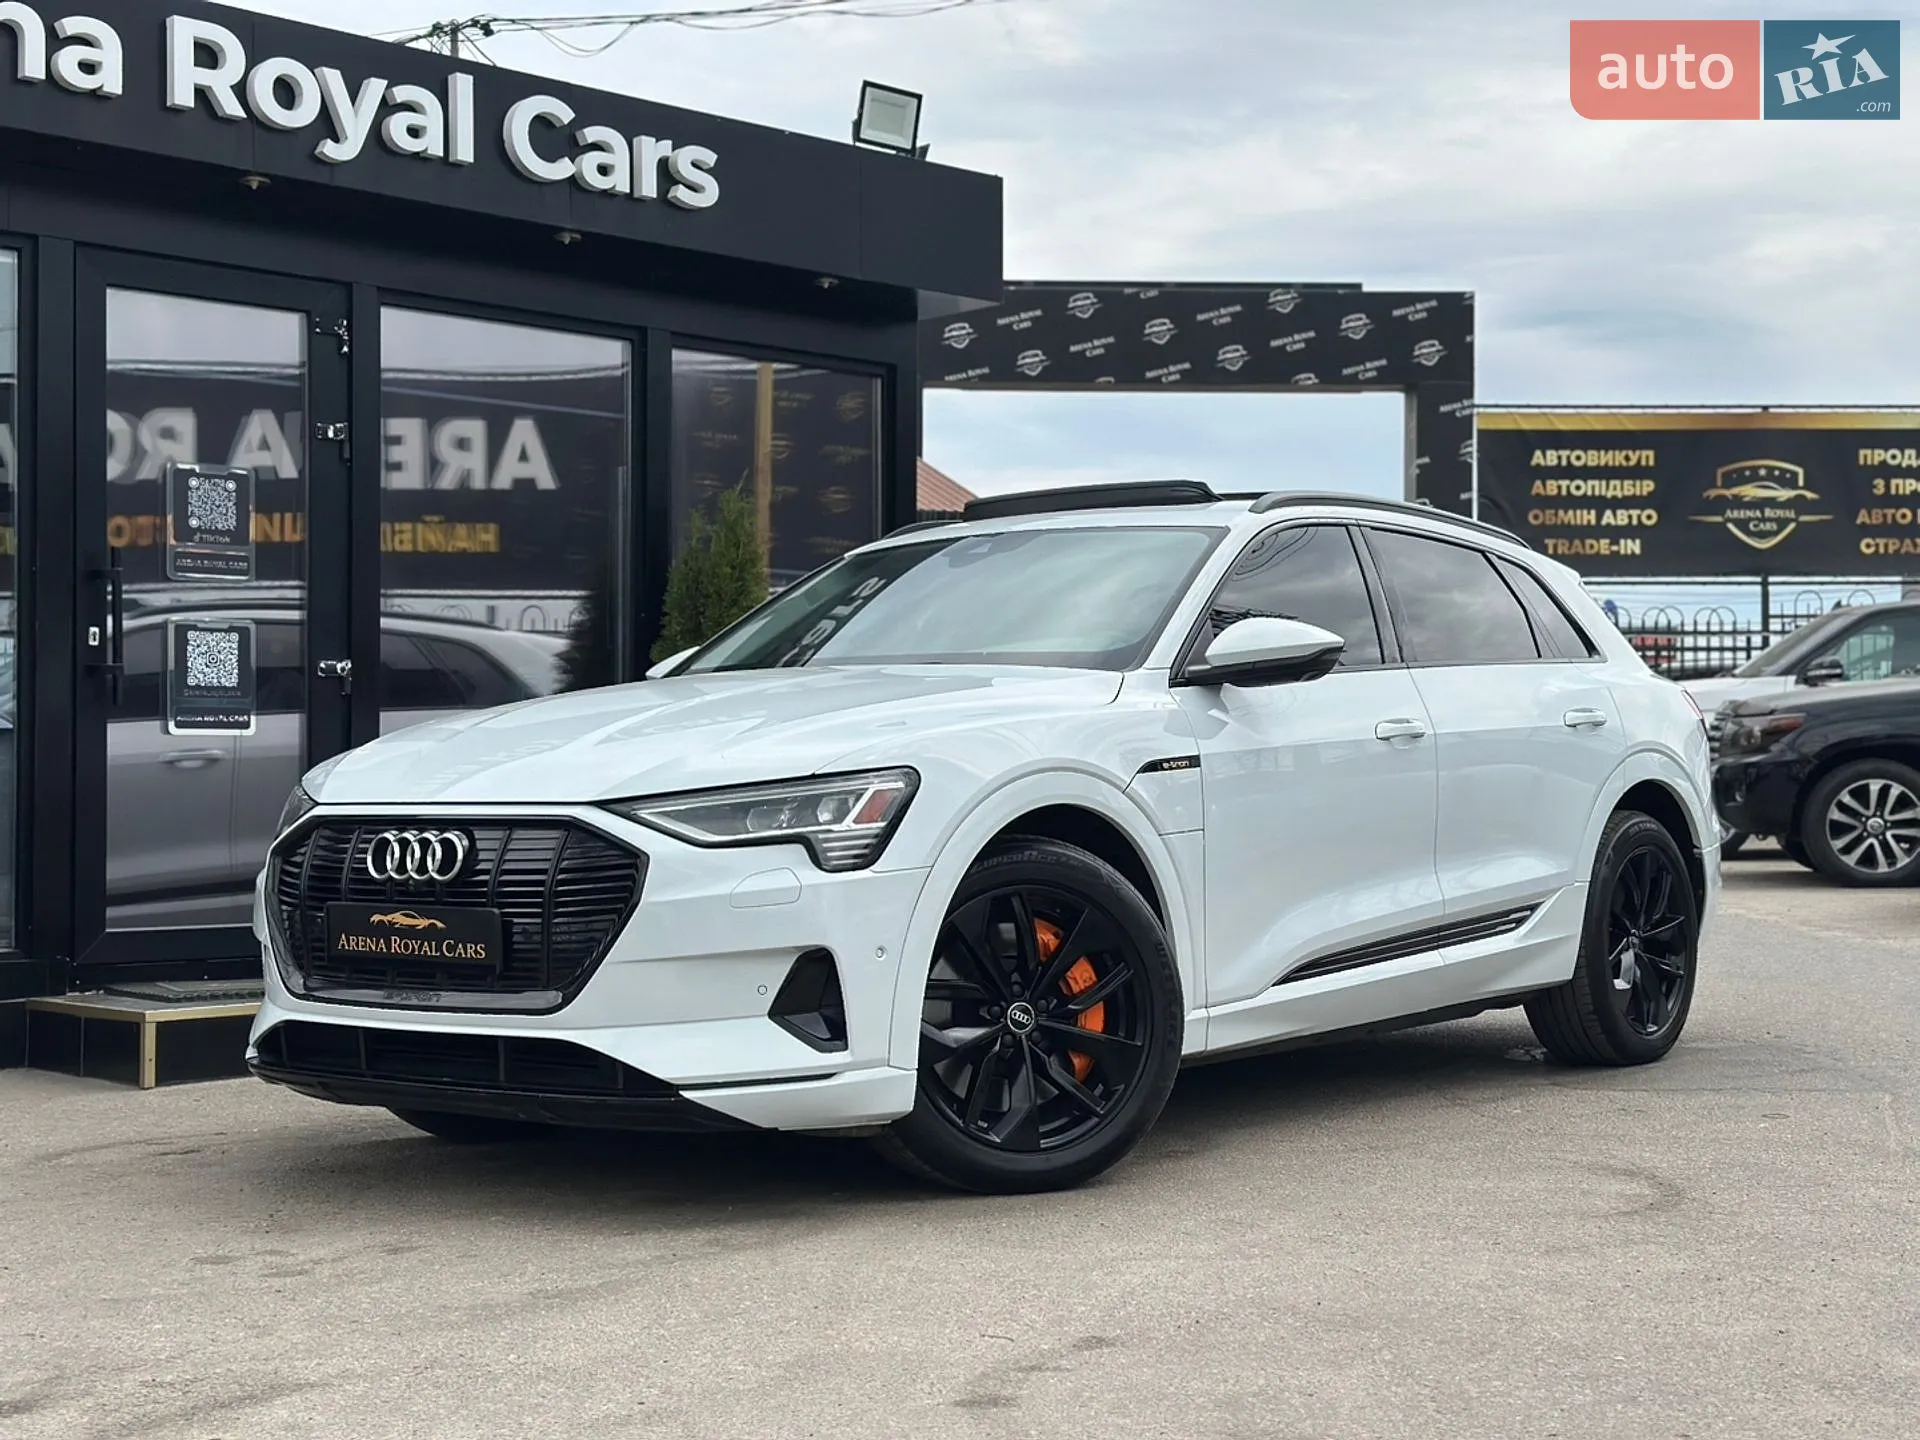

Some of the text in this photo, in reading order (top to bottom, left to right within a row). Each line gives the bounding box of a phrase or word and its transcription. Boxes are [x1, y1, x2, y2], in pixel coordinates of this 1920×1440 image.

[166, 14, 474, 164] Royal
[503, 95, 720, 210] Cars
[1530, 449, 1655, 467] АВТОВИКУП
[1858, 448, 1920, 468] ПРОД
[1531, 479, 1655, 499] АВТОПІДБІР
[1528, 508, 1659, 526] ОБМІН АВТО
[1856, 507, 1913, 525] АВТО
[1544, 538, 1642, 556] TRADE-IN
